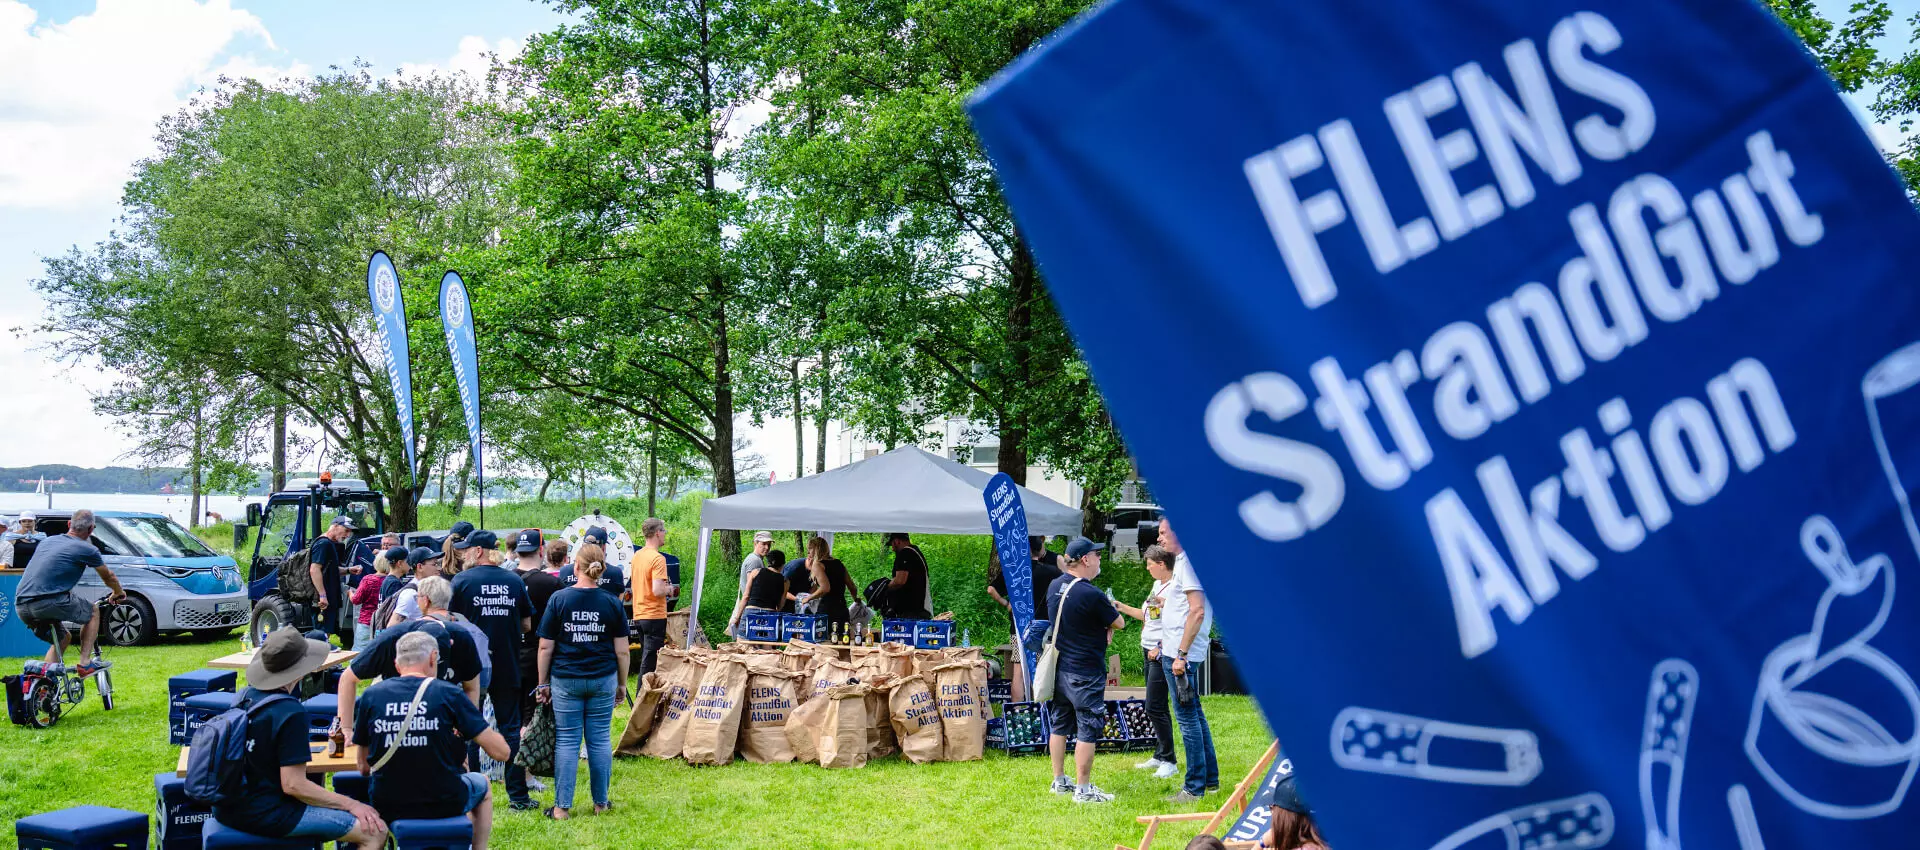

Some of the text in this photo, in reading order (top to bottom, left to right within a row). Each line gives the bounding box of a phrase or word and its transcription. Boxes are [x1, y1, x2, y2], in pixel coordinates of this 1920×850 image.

[1243, 10, 1656, 310] FLENS
[1204, 130, 1824, 542] StrandGut
[991, 480, 1009, 506] FLENS
[1424, 357, 1797, 660] Aktion
[480, 584, 510, 595] FLENS
[473, 595, 516, 608] StrandGut
[481, 606, 509, 617] Aktion
[571, 611, 600, 622] FLENS
[563, 622, 606, 634] StrandGut
[572, 632, 599, 643] Aktion
[699, 685, 727, 697] FLENS
[750, 686, 781, 699] FLENS
[942, 682, 970, 696] FLENS
[748, 698, 791, 711] trandGut
[694, 708, 722, 720] Aktion
[751, 711, 783, 722] Aktion
[942, 708, 973, 719] Aktion
